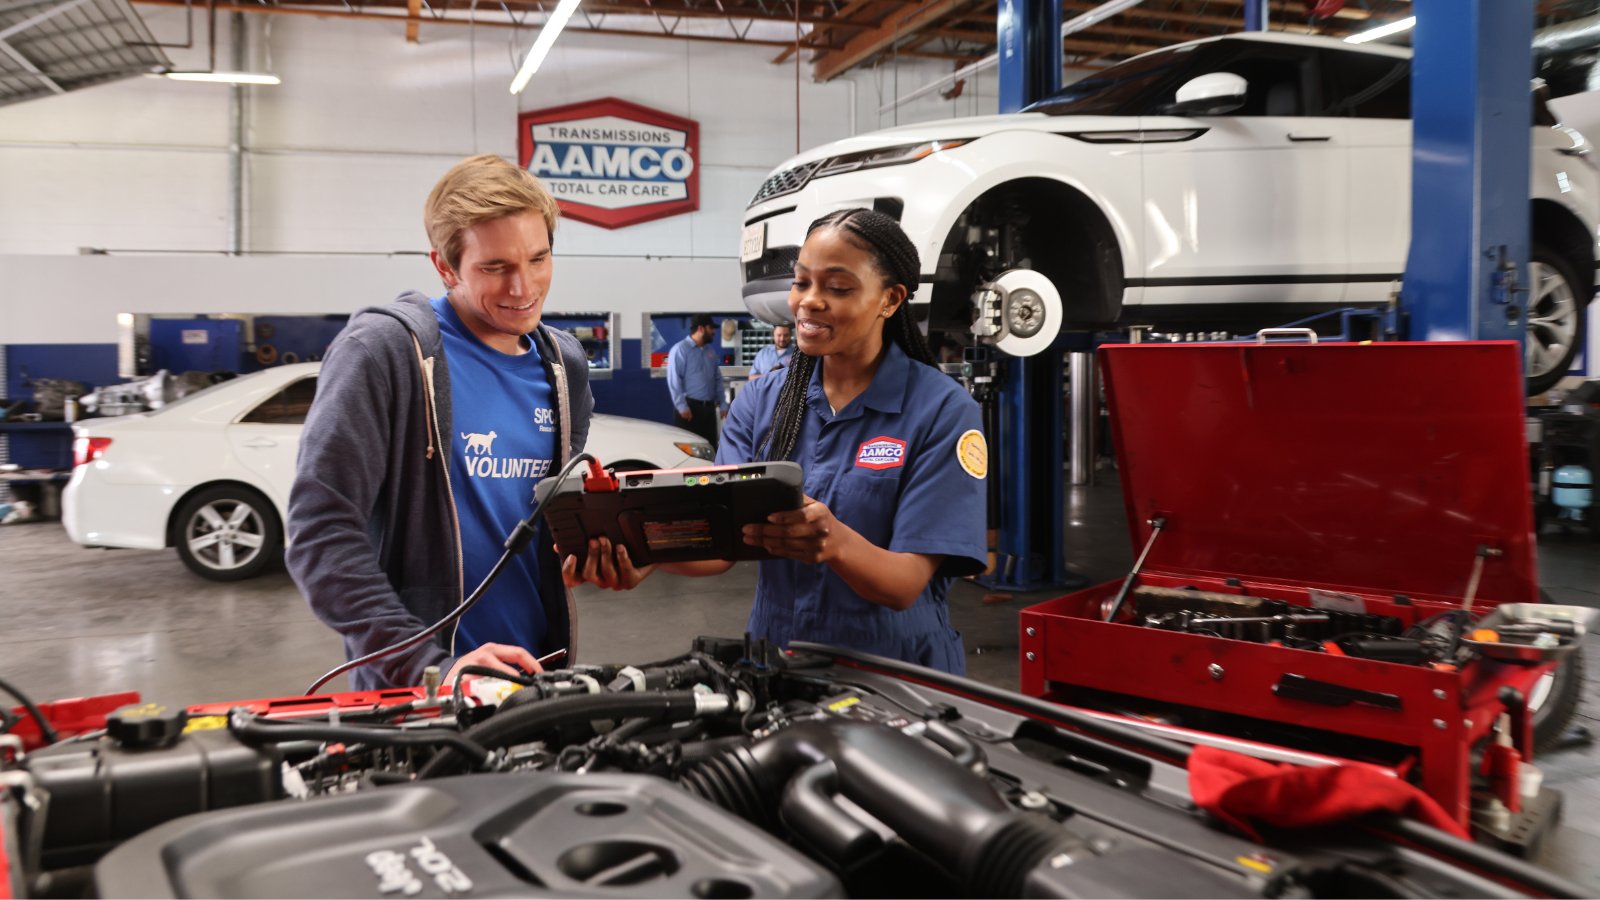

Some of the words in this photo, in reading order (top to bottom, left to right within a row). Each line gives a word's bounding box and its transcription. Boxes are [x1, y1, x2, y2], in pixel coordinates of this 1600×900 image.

[549, 127, 671, 143] TRANSMISSIONS
[528, 144, 694, 181] AAMCO
[550, 182, 594, 195] TOTAL
[598, 183, 628, 196] CAR
[632, 185, 670, 197] CARE
[859, 448, 903, 458] AAMCO
